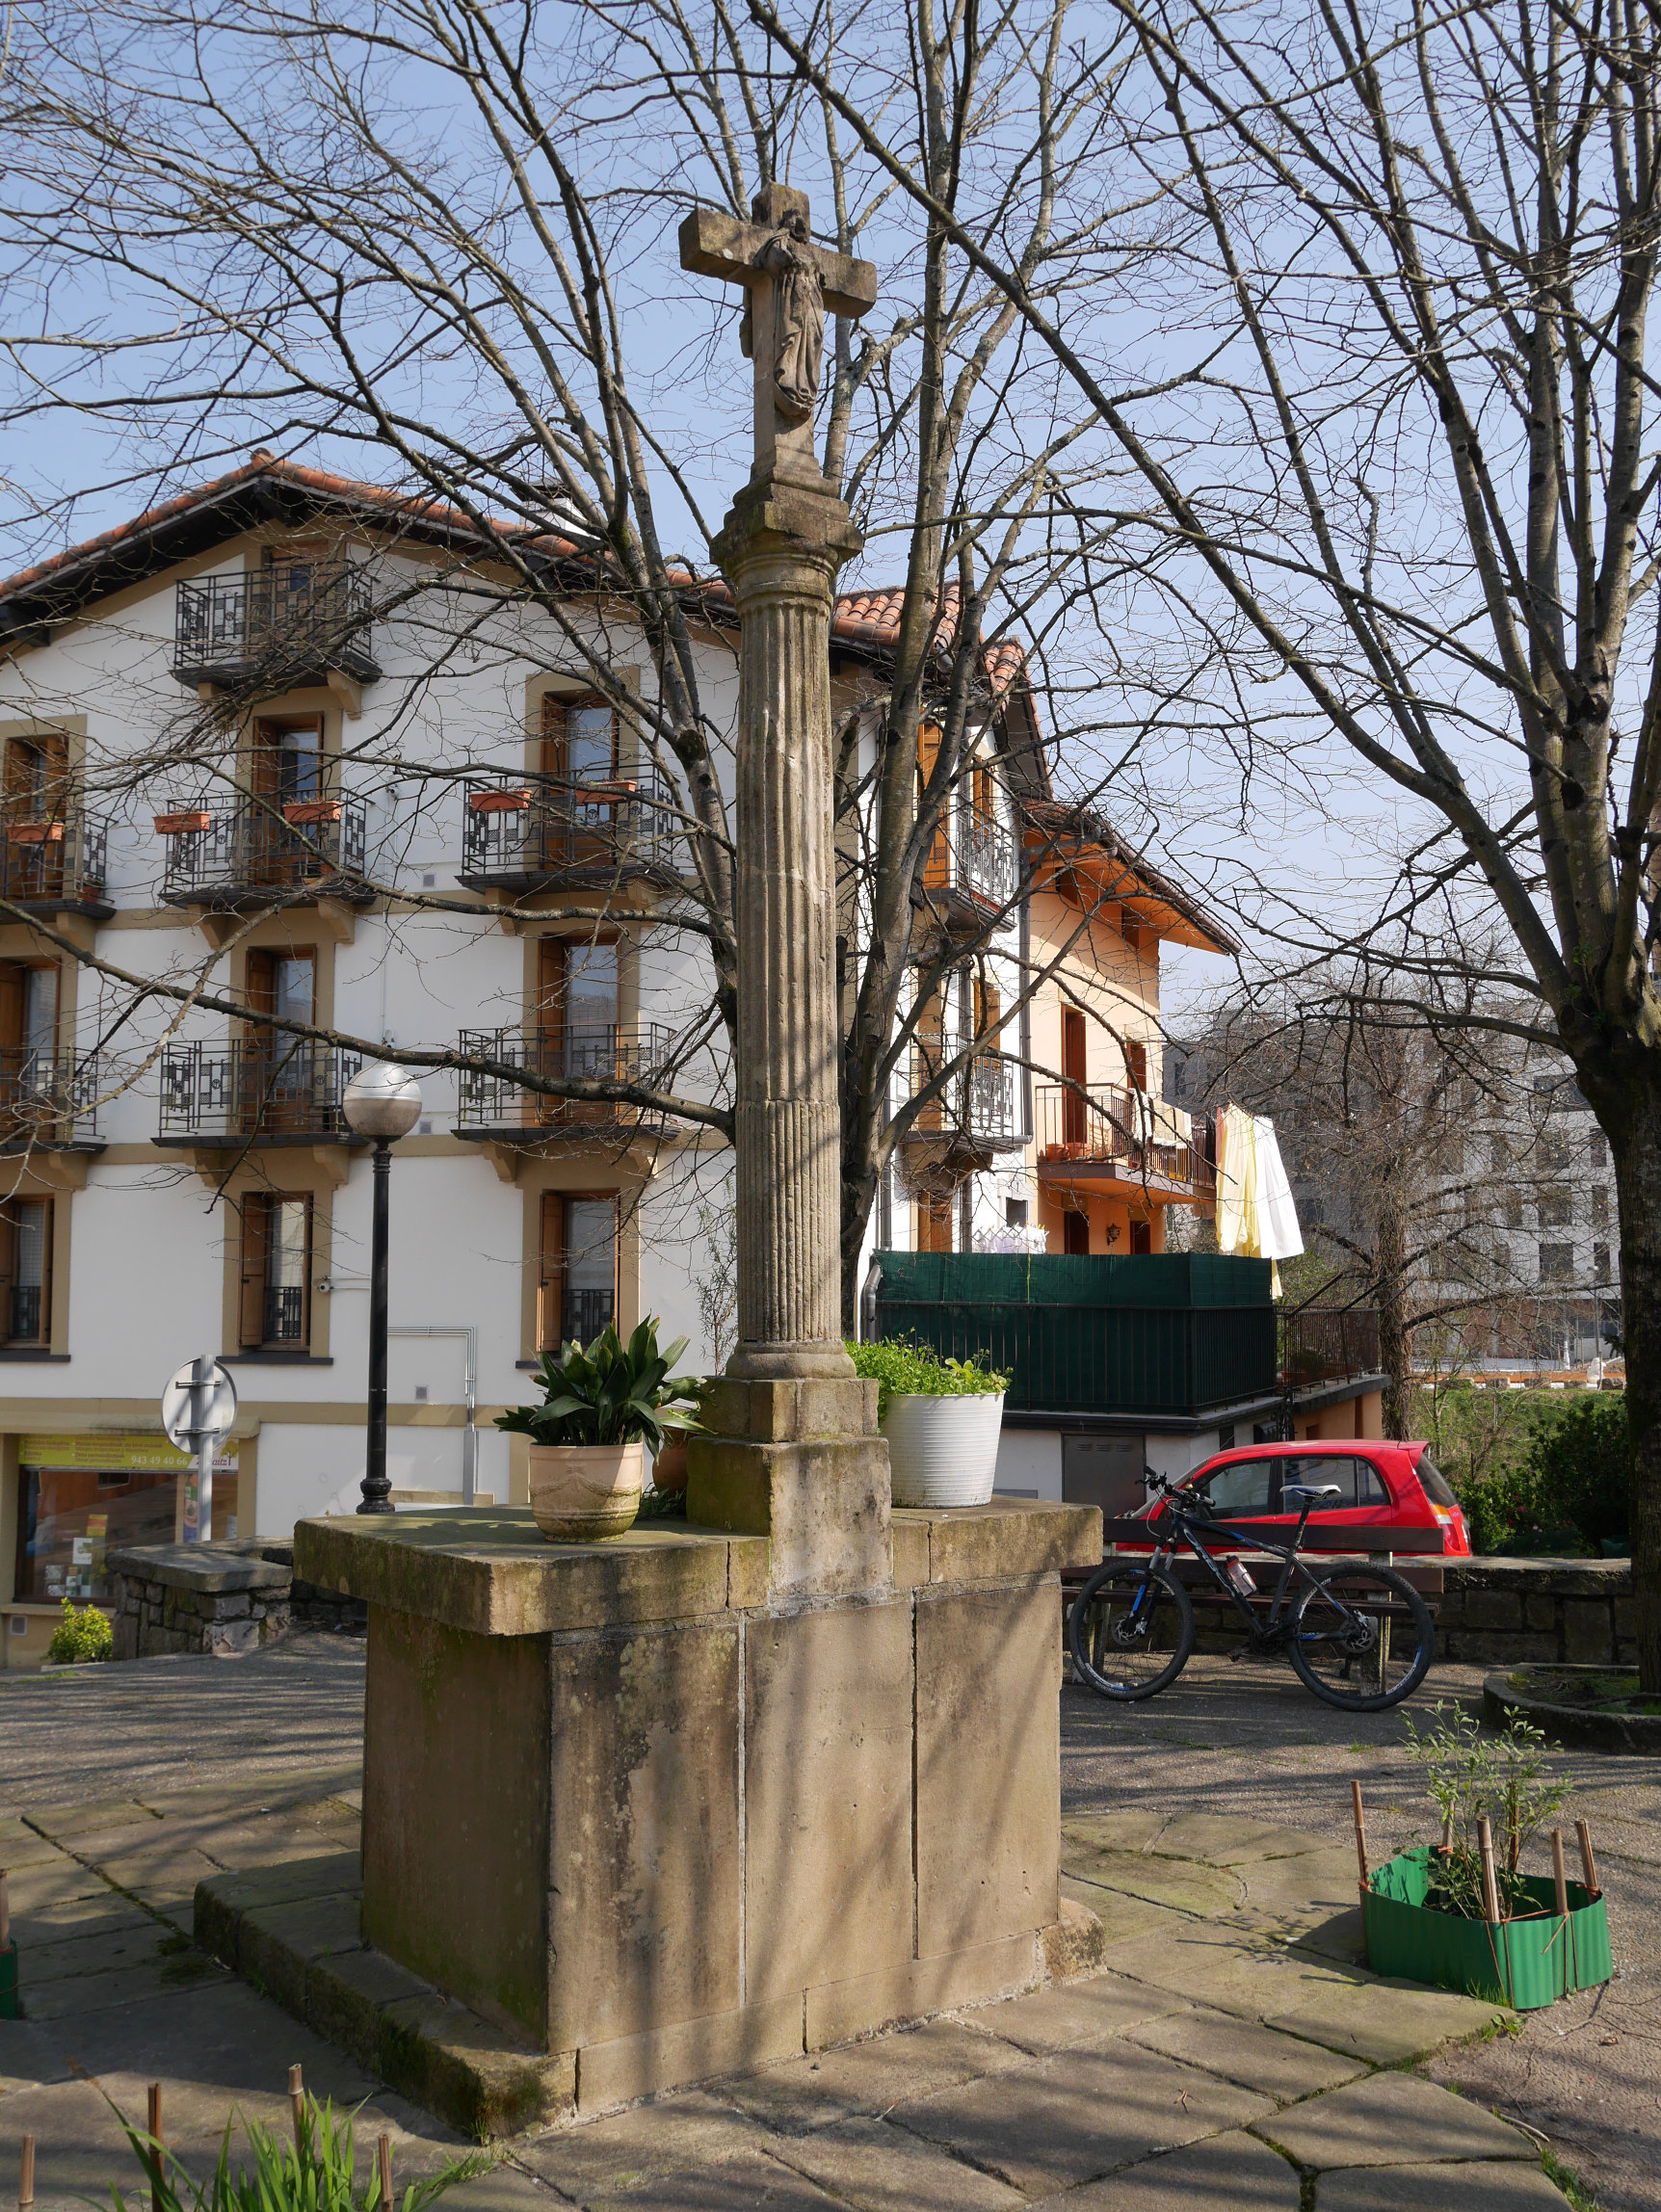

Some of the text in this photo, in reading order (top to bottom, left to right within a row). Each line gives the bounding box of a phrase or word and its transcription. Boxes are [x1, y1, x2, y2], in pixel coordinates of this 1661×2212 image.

[130, 1456, 147, 1464] 943
[149, 1456, 161, 1464] 49
[163, 1456, 174, 1465] 40
[176, 1457, 188, 1465] 66
